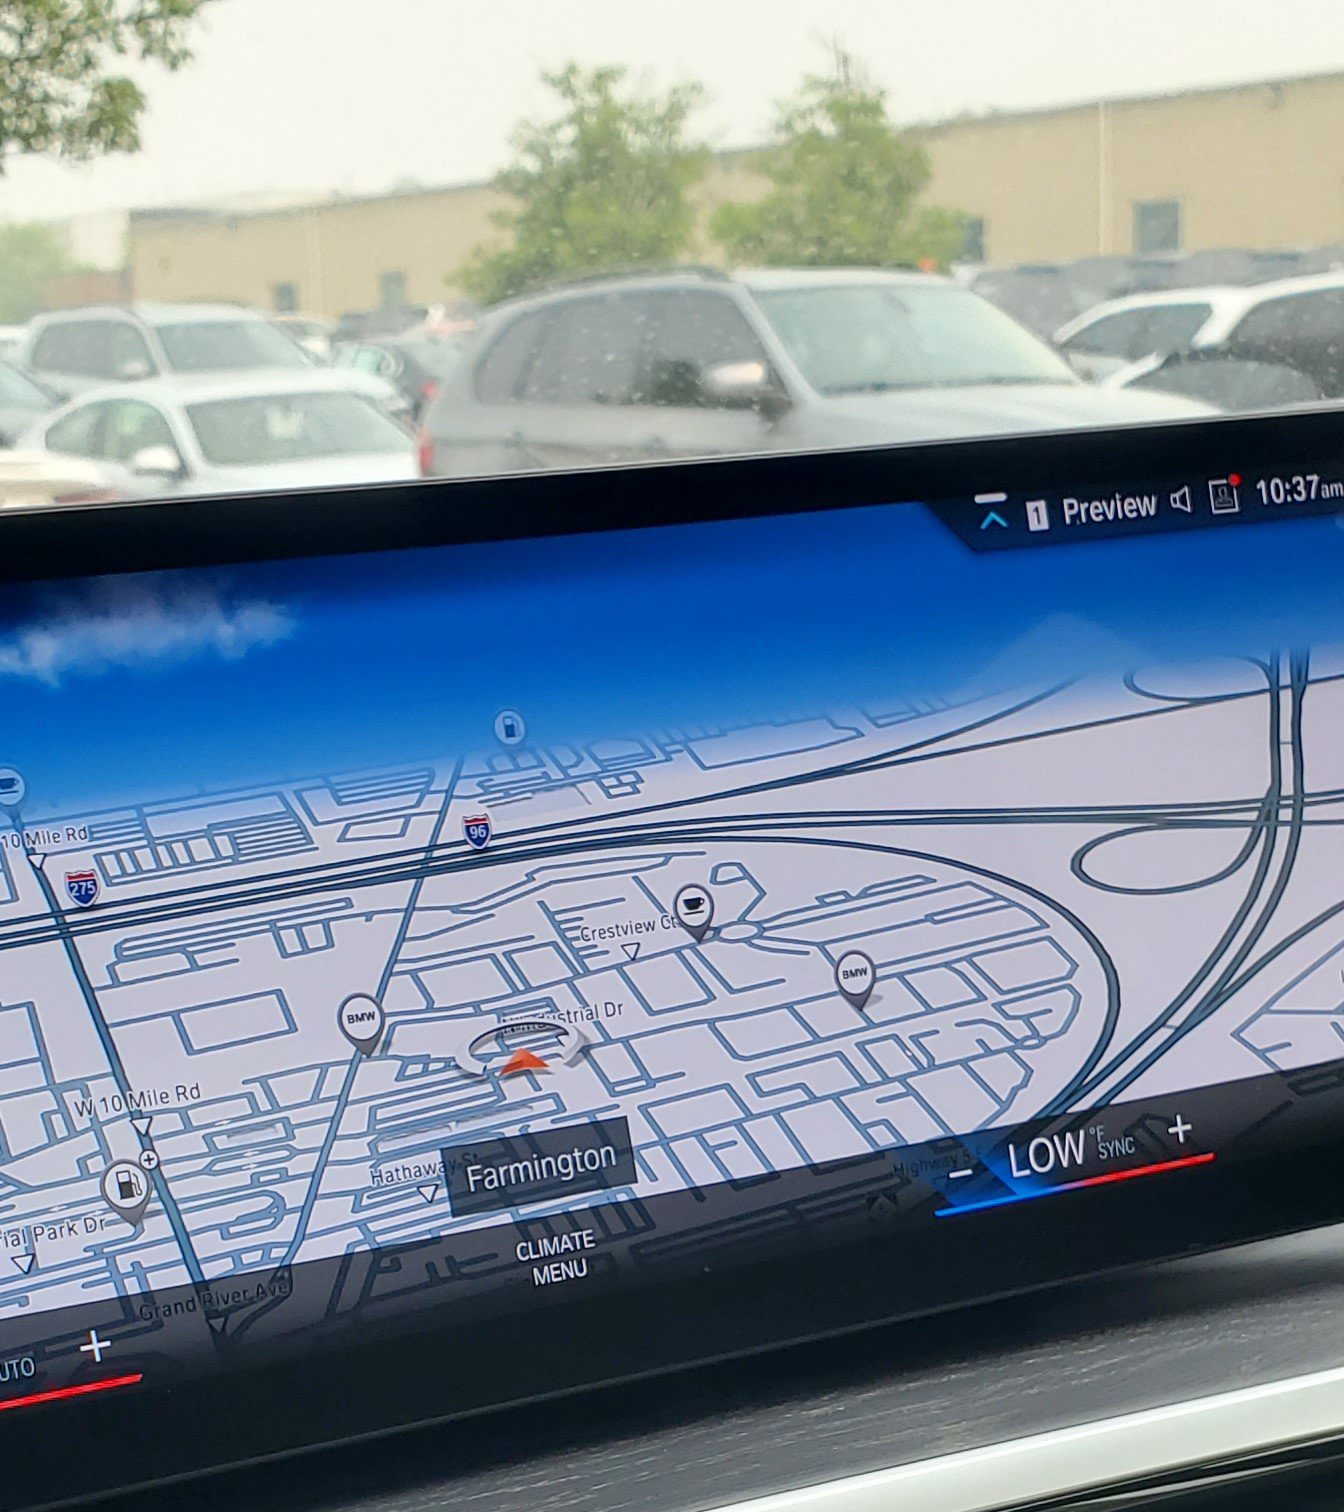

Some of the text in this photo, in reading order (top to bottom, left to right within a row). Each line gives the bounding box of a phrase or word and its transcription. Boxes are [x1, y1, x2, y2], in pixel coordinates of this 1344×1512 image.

[1256, 474, 1344, 505] 10:37am
[1063, 493, 1157, 526] Preview
[1, 833, 21, 849] 10
[25, 829, 61, 846] Mile
[65, 826, 88, 841] Rd
[469, 823, 487, 840] 96
[68, 880, 97, 897] 275
[580, 914, 679, 942] Crestview Ct
[842, 966, 867, 980] BMW
[347, 1010, 375, 1024] BMW
[604, 1001, 623, 1018] Dr
[74, 1082, 201, 1117] W 10 Mile Rd
[1008, 1129, 1085, 1178] LOW
[1098, 1137, 1136, 1159] SYNC
[369, 1157, 460, 1187] Hathaway
[465, 1144, 618, 1193] Farmington
[33, 1220, 78, 1243] Park
[83, 1215, 106, 1234] Dr
[515, 1229, 597, 1263] CLIMATE
[532, 1257, 589, 1287] MENU
[139, 1282, 289, 1321] Grand River Ave
